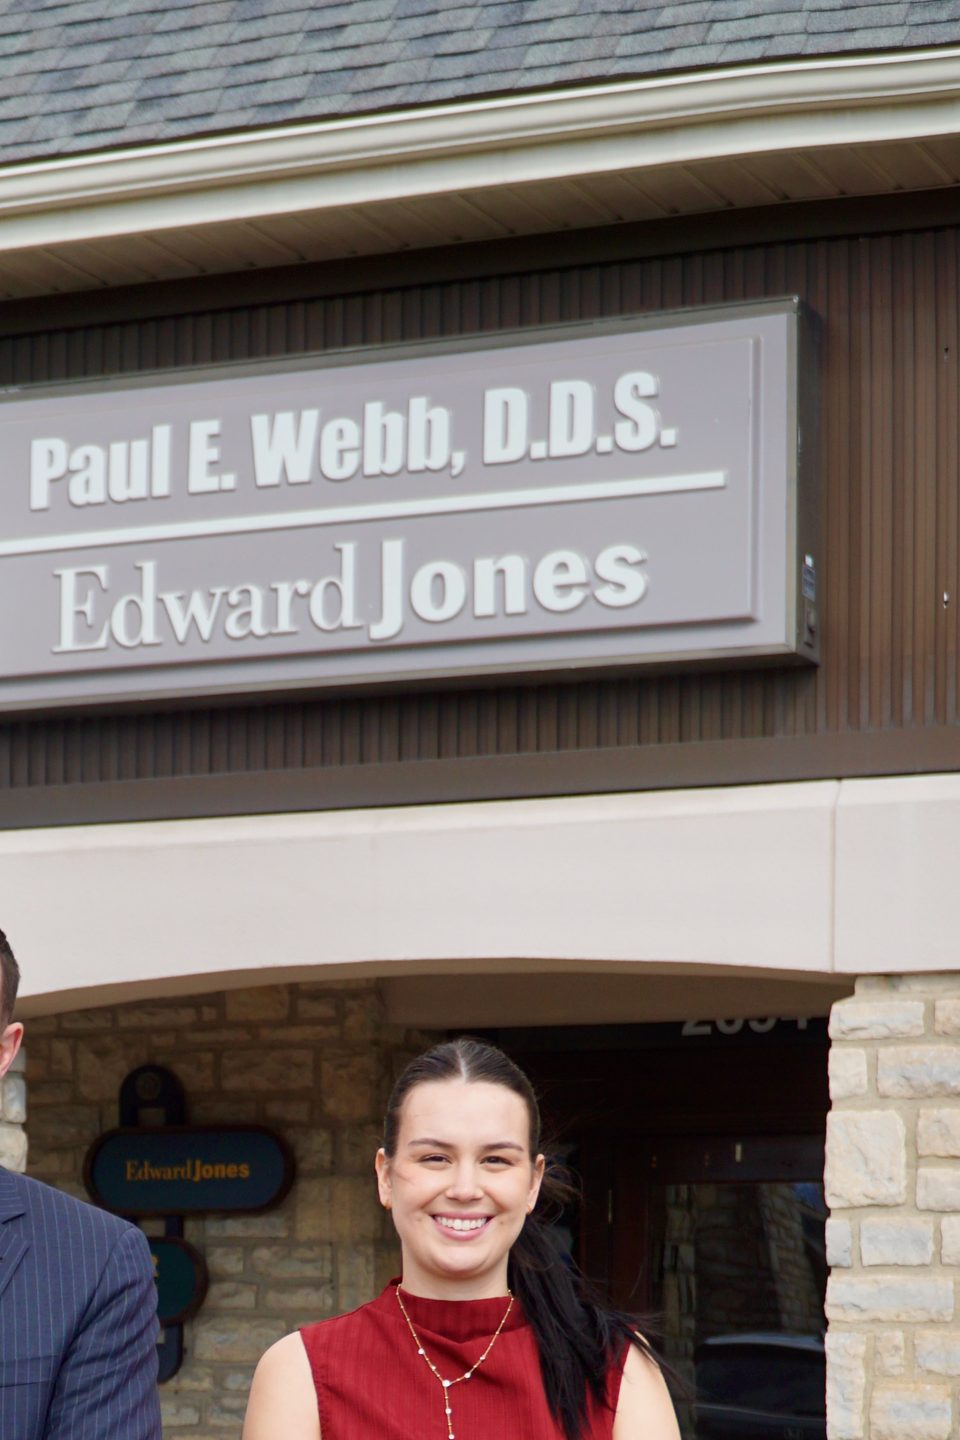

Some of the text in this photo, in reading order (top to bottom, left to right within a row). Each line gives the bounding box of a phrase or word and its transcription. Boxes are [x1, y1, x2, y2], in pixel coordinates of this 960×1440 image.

[29, 371, 678, 510] Paul E. Webb, D.D.S.
